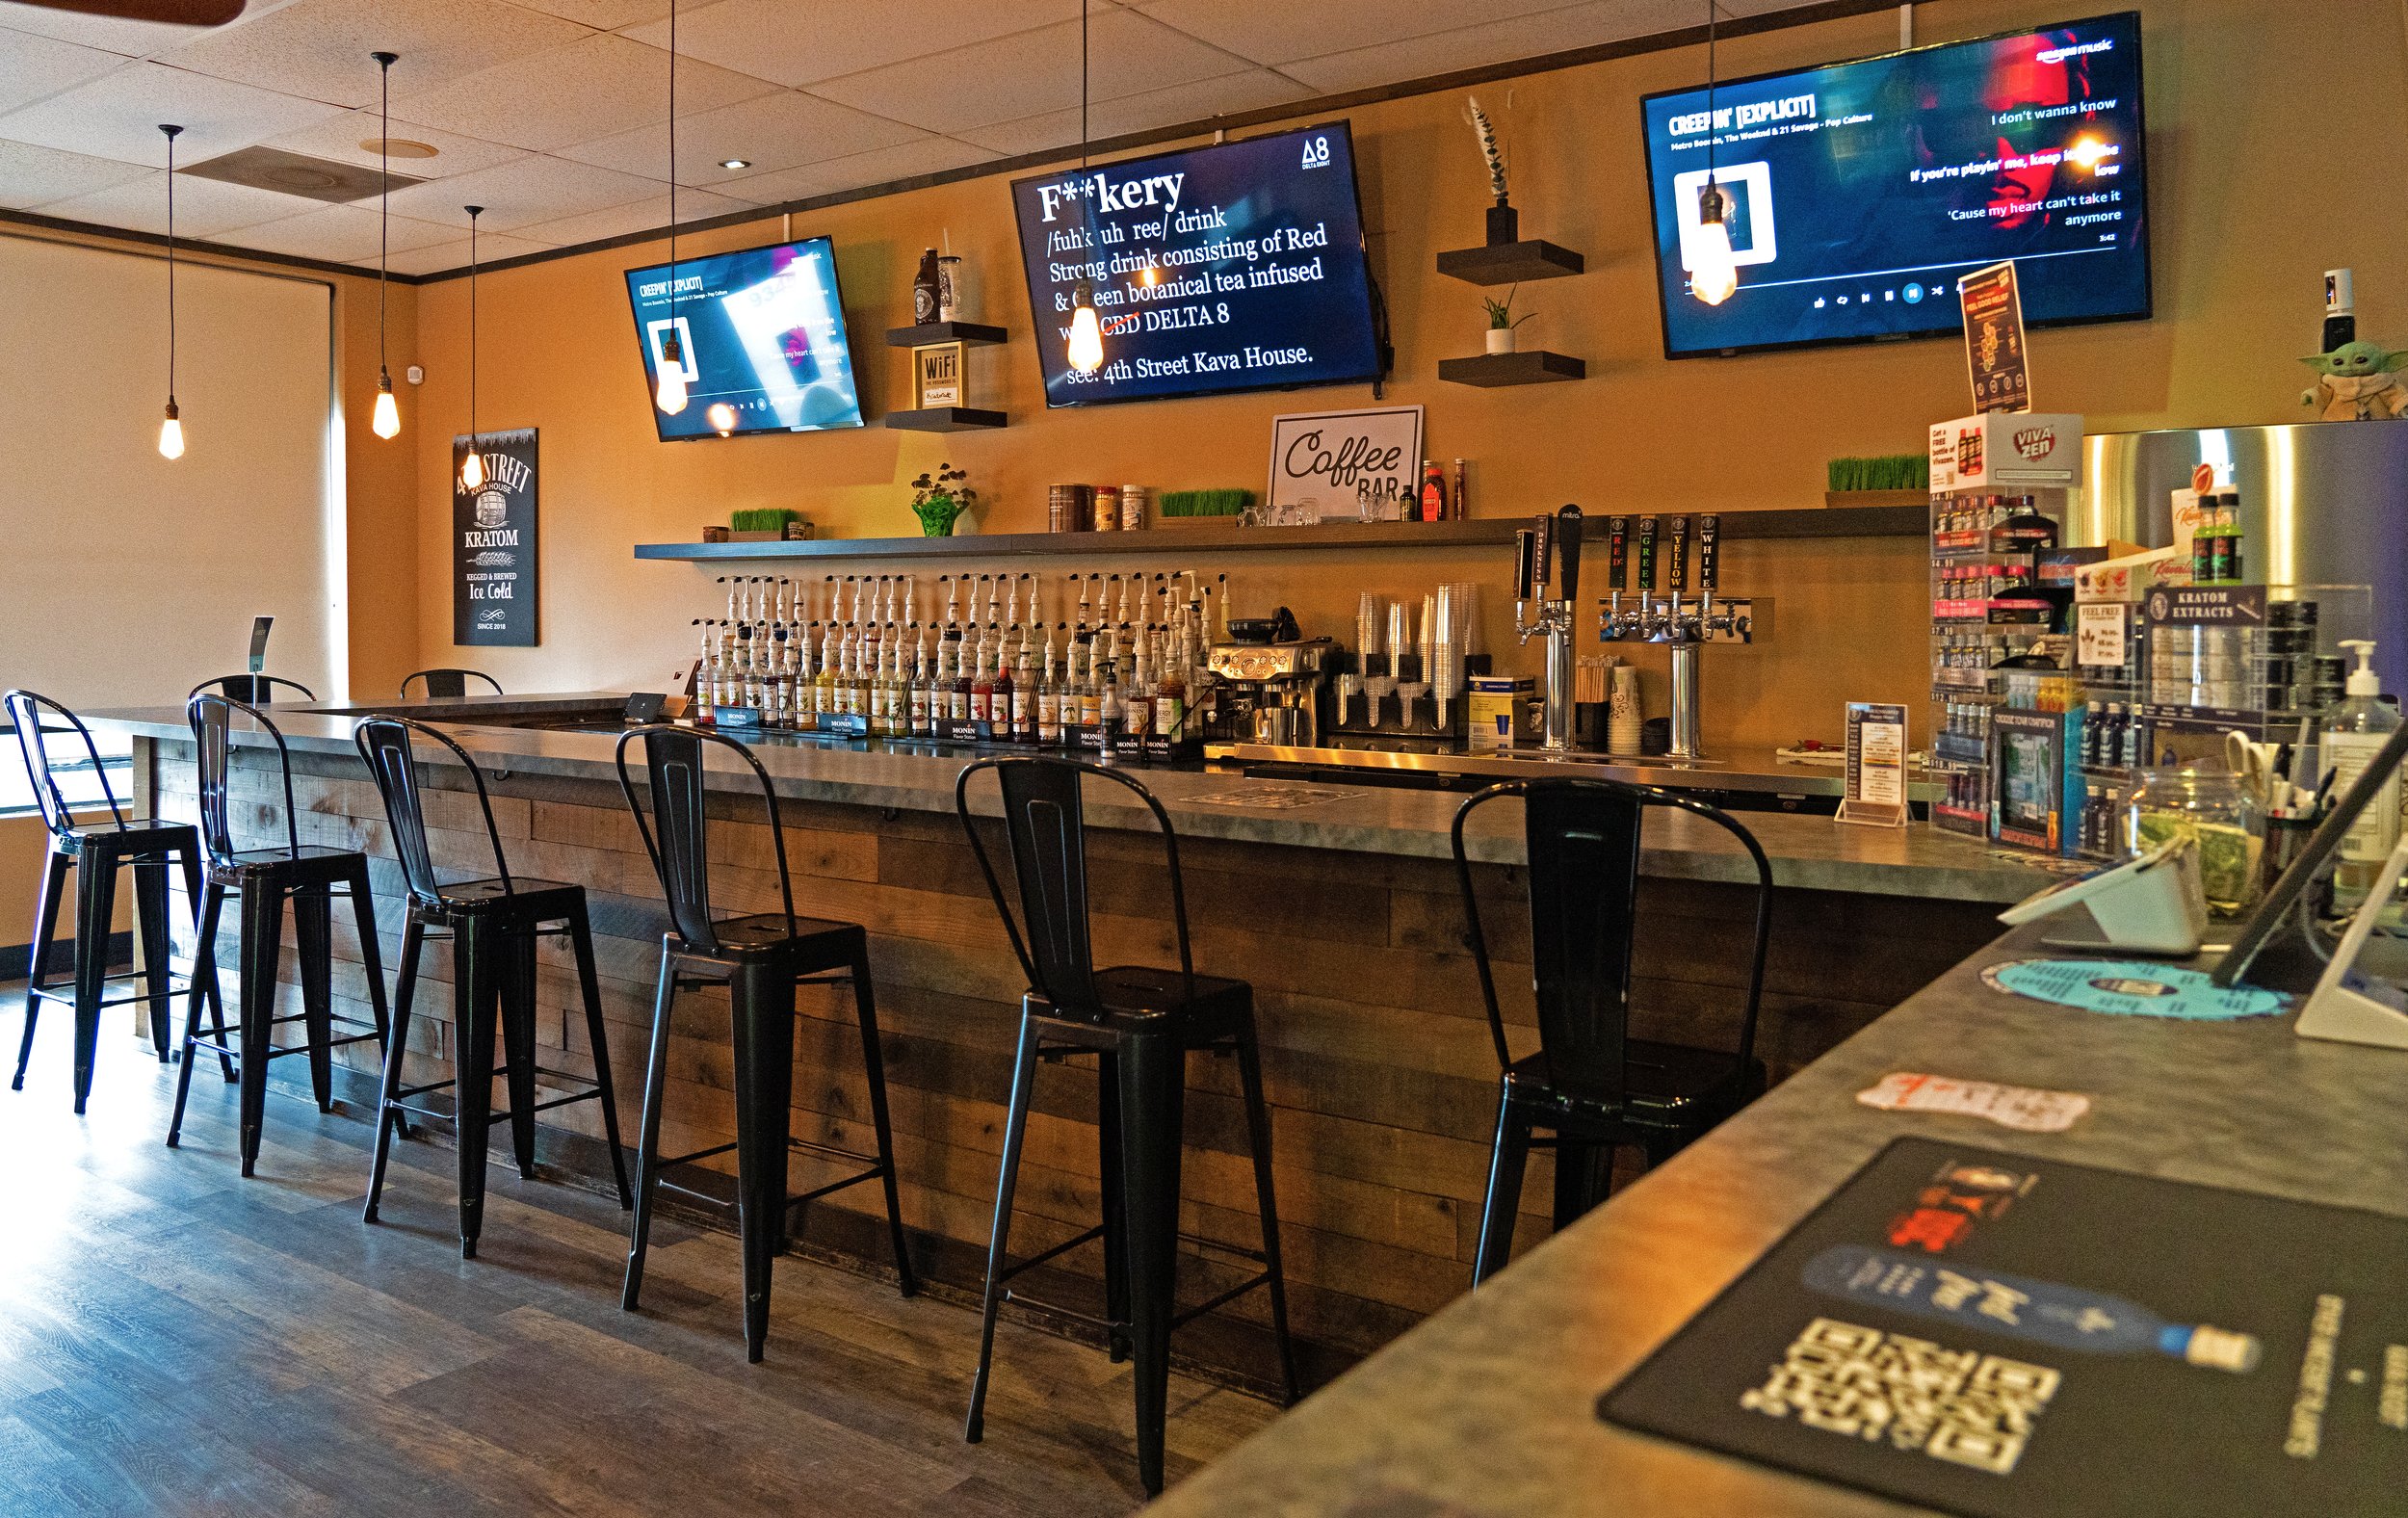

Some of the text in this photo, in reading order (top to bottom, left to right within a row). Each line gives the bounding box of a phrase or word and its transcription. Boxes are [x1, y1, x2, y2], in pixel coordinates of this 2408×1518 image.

[2078, 39, 2112, 55] music
[1736, 93, 1817, 130] [EXPLICIT]
[1991, 98, 2116, 125] I don't wanna know
[1670, 141, 1693, 151] Metro
[1725, 133, 1740, 144] The
[1780, 126, 1790, 135] 21
[1791, 122, 1819, 133] Savage
[1825, 118, 1842, 128] Pop
[1843, 114, 1873, 125] Culture
[1910, 170, 1920, 182] If
[1922, 166, 1958, 183] you're
[1961, 160, 2002, 177] playin'
[2004, 156, 2028, 169] me,
[2029, 153, 2061, 168] keep
[2094, 164, 2120, 177] low
[1948, 190, 2121, 221] 'Cause my heart can't take it
[2065, 209, 2122, 226] anymore
[1101, 222, 1125, 245] uh
[1133, 213, 1168, 242] ree/
[1175, 205, 1227, 233] drink
[1050, 222, 1328, 282] Strong drink consisting of Red
[1055, 292, 1069, 312] &
[1127, 271, 1212, 302] botanical
[1215, 273, 1245, 293] tea
[1248, 257, 1323, 288] infused
[1101, 313, 1140, 336] CBD
[1144, 304, 1215, 332] DELTA
[1217, 301, 1230, 323] 8
[925, 354, 955, 380] WiFi
[1104, 358, 1132, 385] 4th
[1137, 353, 1190, 379] Street
[1192, 351, 1241, 373] Kava
[1243, 346, 1313, 368] House.
[1932, 437, 1946, 447] FREE
[2018, 427, 2051, 445] VIVA
[1285, 429, 1401, 487] Coffee
[484, 454, 532, 493] STREET
[471, 483, 511, 496] KAVA HOUSE
[1357, 477, 1399, 502] BAR
[464, 530, 519, 548] KRATOM
[1613, 536, 1622, 566] RED
[1641, 537, 1650, 589] GREEN
[1671, 536, 1682, 586] YELLOW
[1702, 535, 1714, 588] WHITE
[470, 582, 513, 599] Ice Cold
[2179, 591, 2227, 603] KRATOM
[2081, 607, 2120, 616] FEEL FREE
[2173, 606, 2233, 617] EXTRACTS
[953, 725, 976, 734] MONIN
[1081, 731, 1102, 740] MONI
